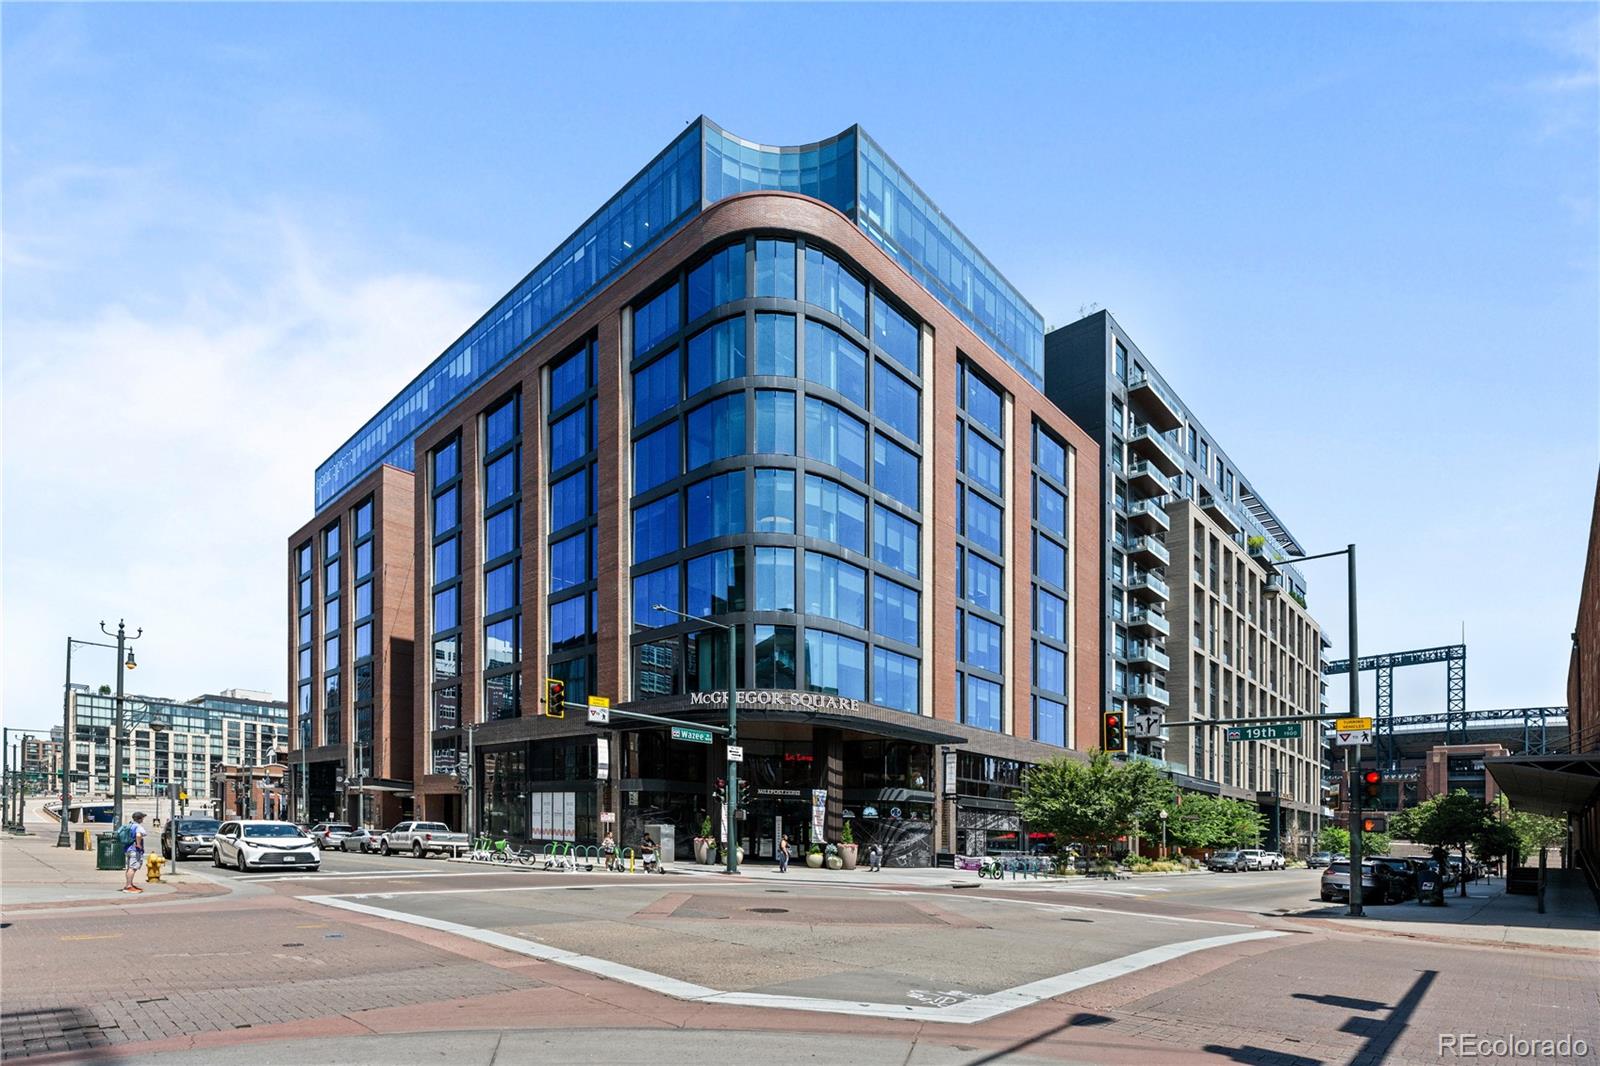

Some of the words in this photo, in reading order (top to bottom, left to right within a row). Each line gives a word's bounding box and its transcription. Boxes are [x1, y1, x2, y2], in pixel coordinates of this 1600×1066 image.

[690, 691, 786, 705] McGREGOR
[790, 692, 860, 711] SQUARE
[681, 730, 705, 741] Wazee
[1246, 727, 1276, 739] 19th
